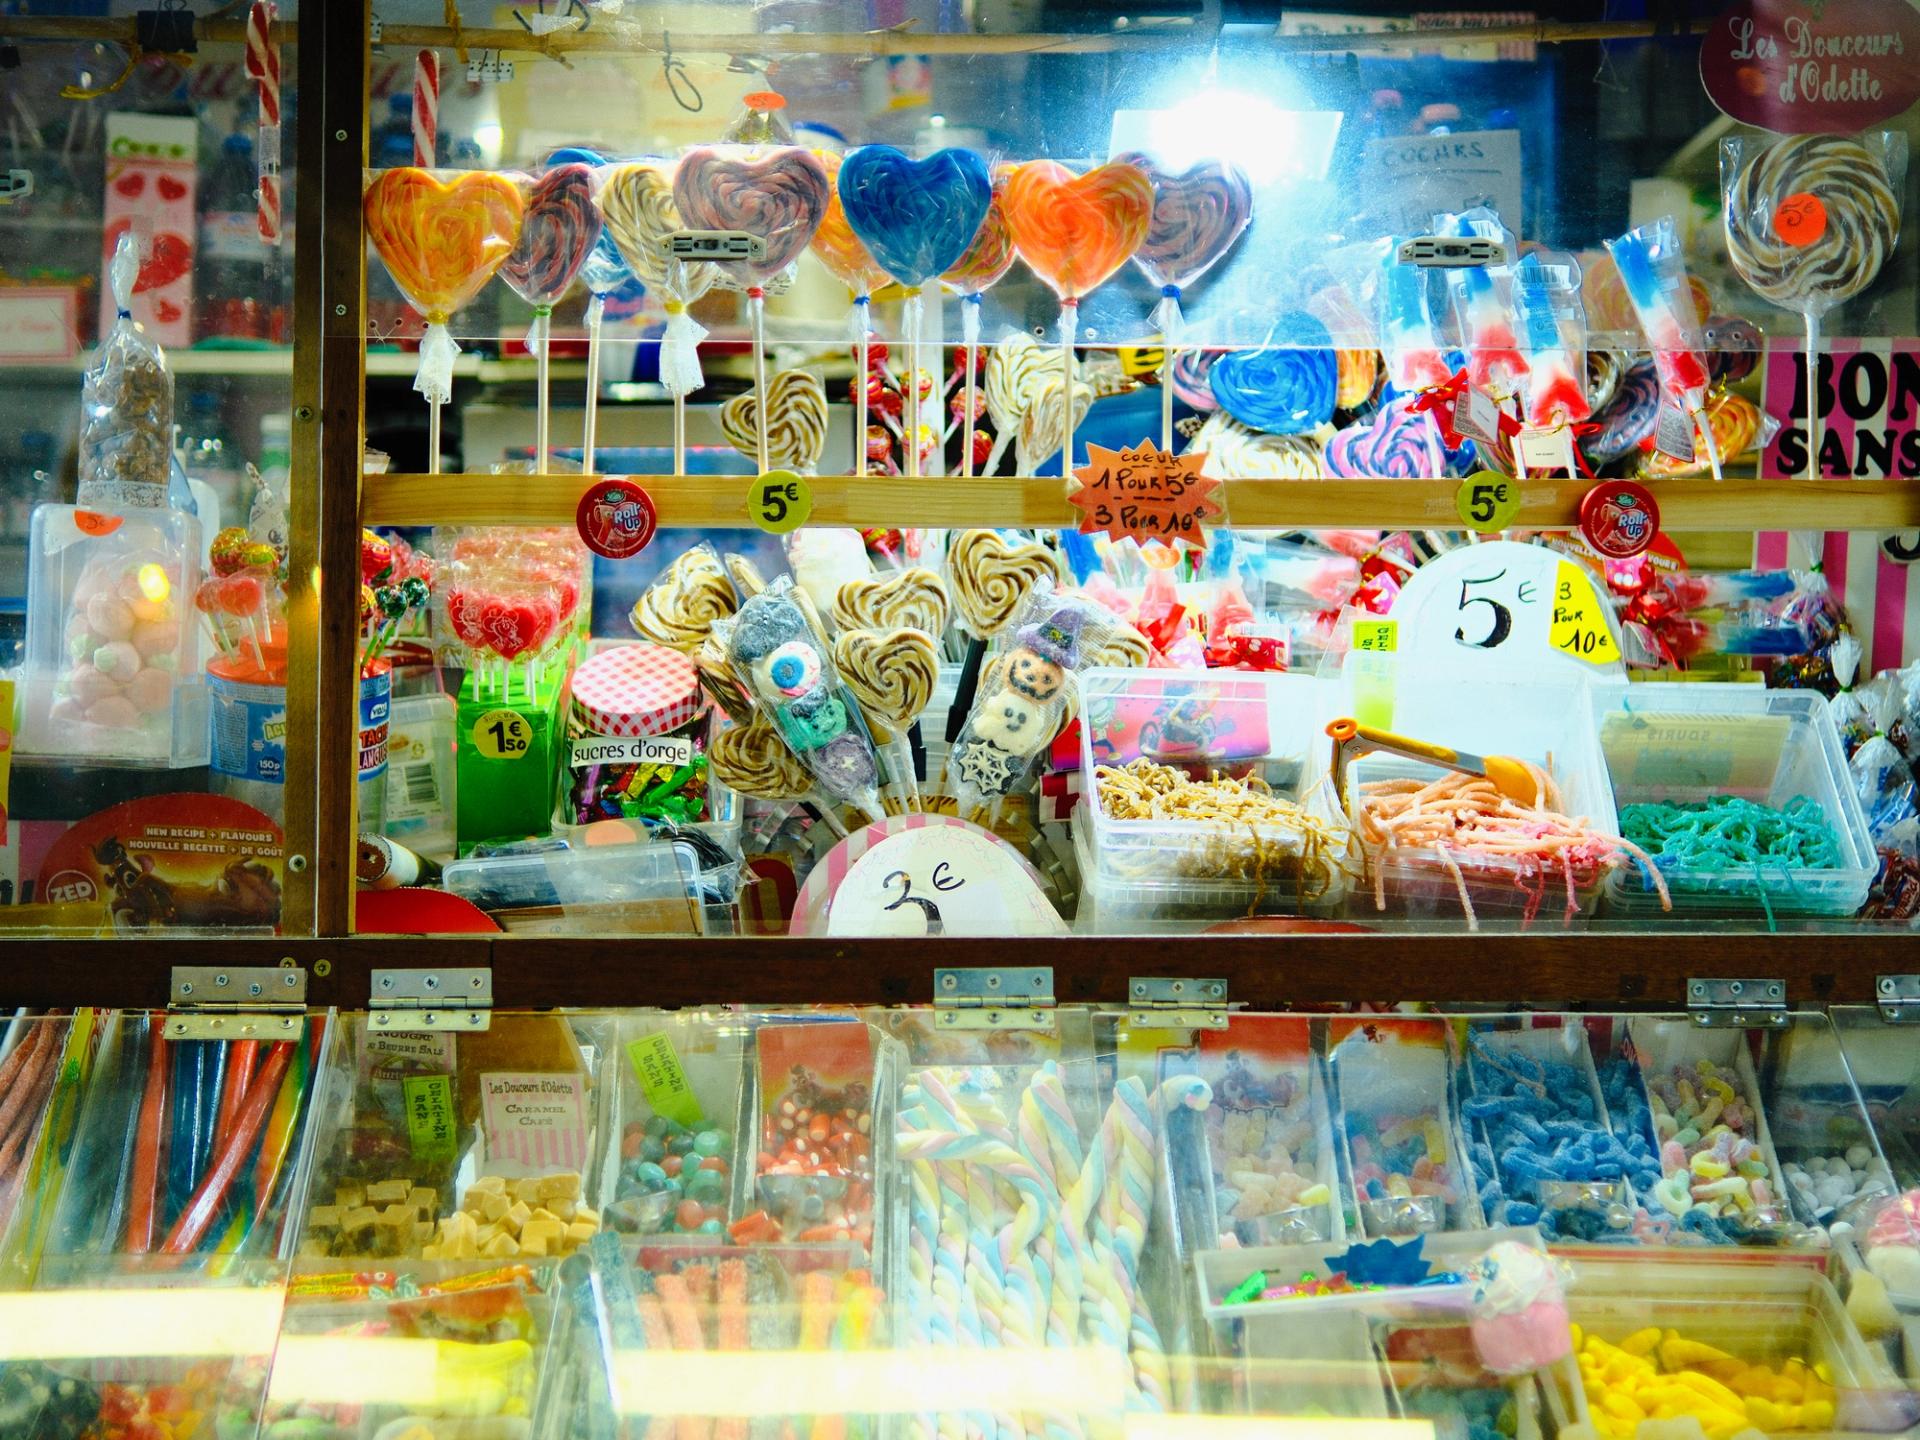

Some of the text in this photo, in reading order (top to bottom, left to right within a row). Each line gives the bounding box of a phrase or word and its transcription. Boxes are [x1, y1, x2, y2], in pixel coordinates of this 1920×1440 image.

[1728, 16, 1905, 60] Les Douceurs
[1779, 60, 1883, 104] d'Odette
[1776, 427, 1920, 477] SANS
[1092, 467, 1111, 490] 1
[1165, 471, 1199, 496] 5€
[761, 482, 799, 523] 5€
[1094, 504, 1114, 526] 3
[1470, 483, 1508, 522] 5€
[1559, 581, 1572, 601] 3
[1454, 568, 1537, 649] 5€
[1560, 628, 1608, 654] 10€
[574, 739, 688, 763] sucres d'orge
[146, 827, 168, 837] NEW
[171, 828, 205, 839] RECIPE
[221, 831, 273, 842] FLAVOURS
[129, 840, 180, 851] NOUVELLE
[183, 843, 226, 854] RECETTE
[240, 847, 254, 856] DE
[50, 879, 93, 901] ZED
[488, 1081, 503, 1095] Les
[504, 1080, 540, 1094] Douceurs
